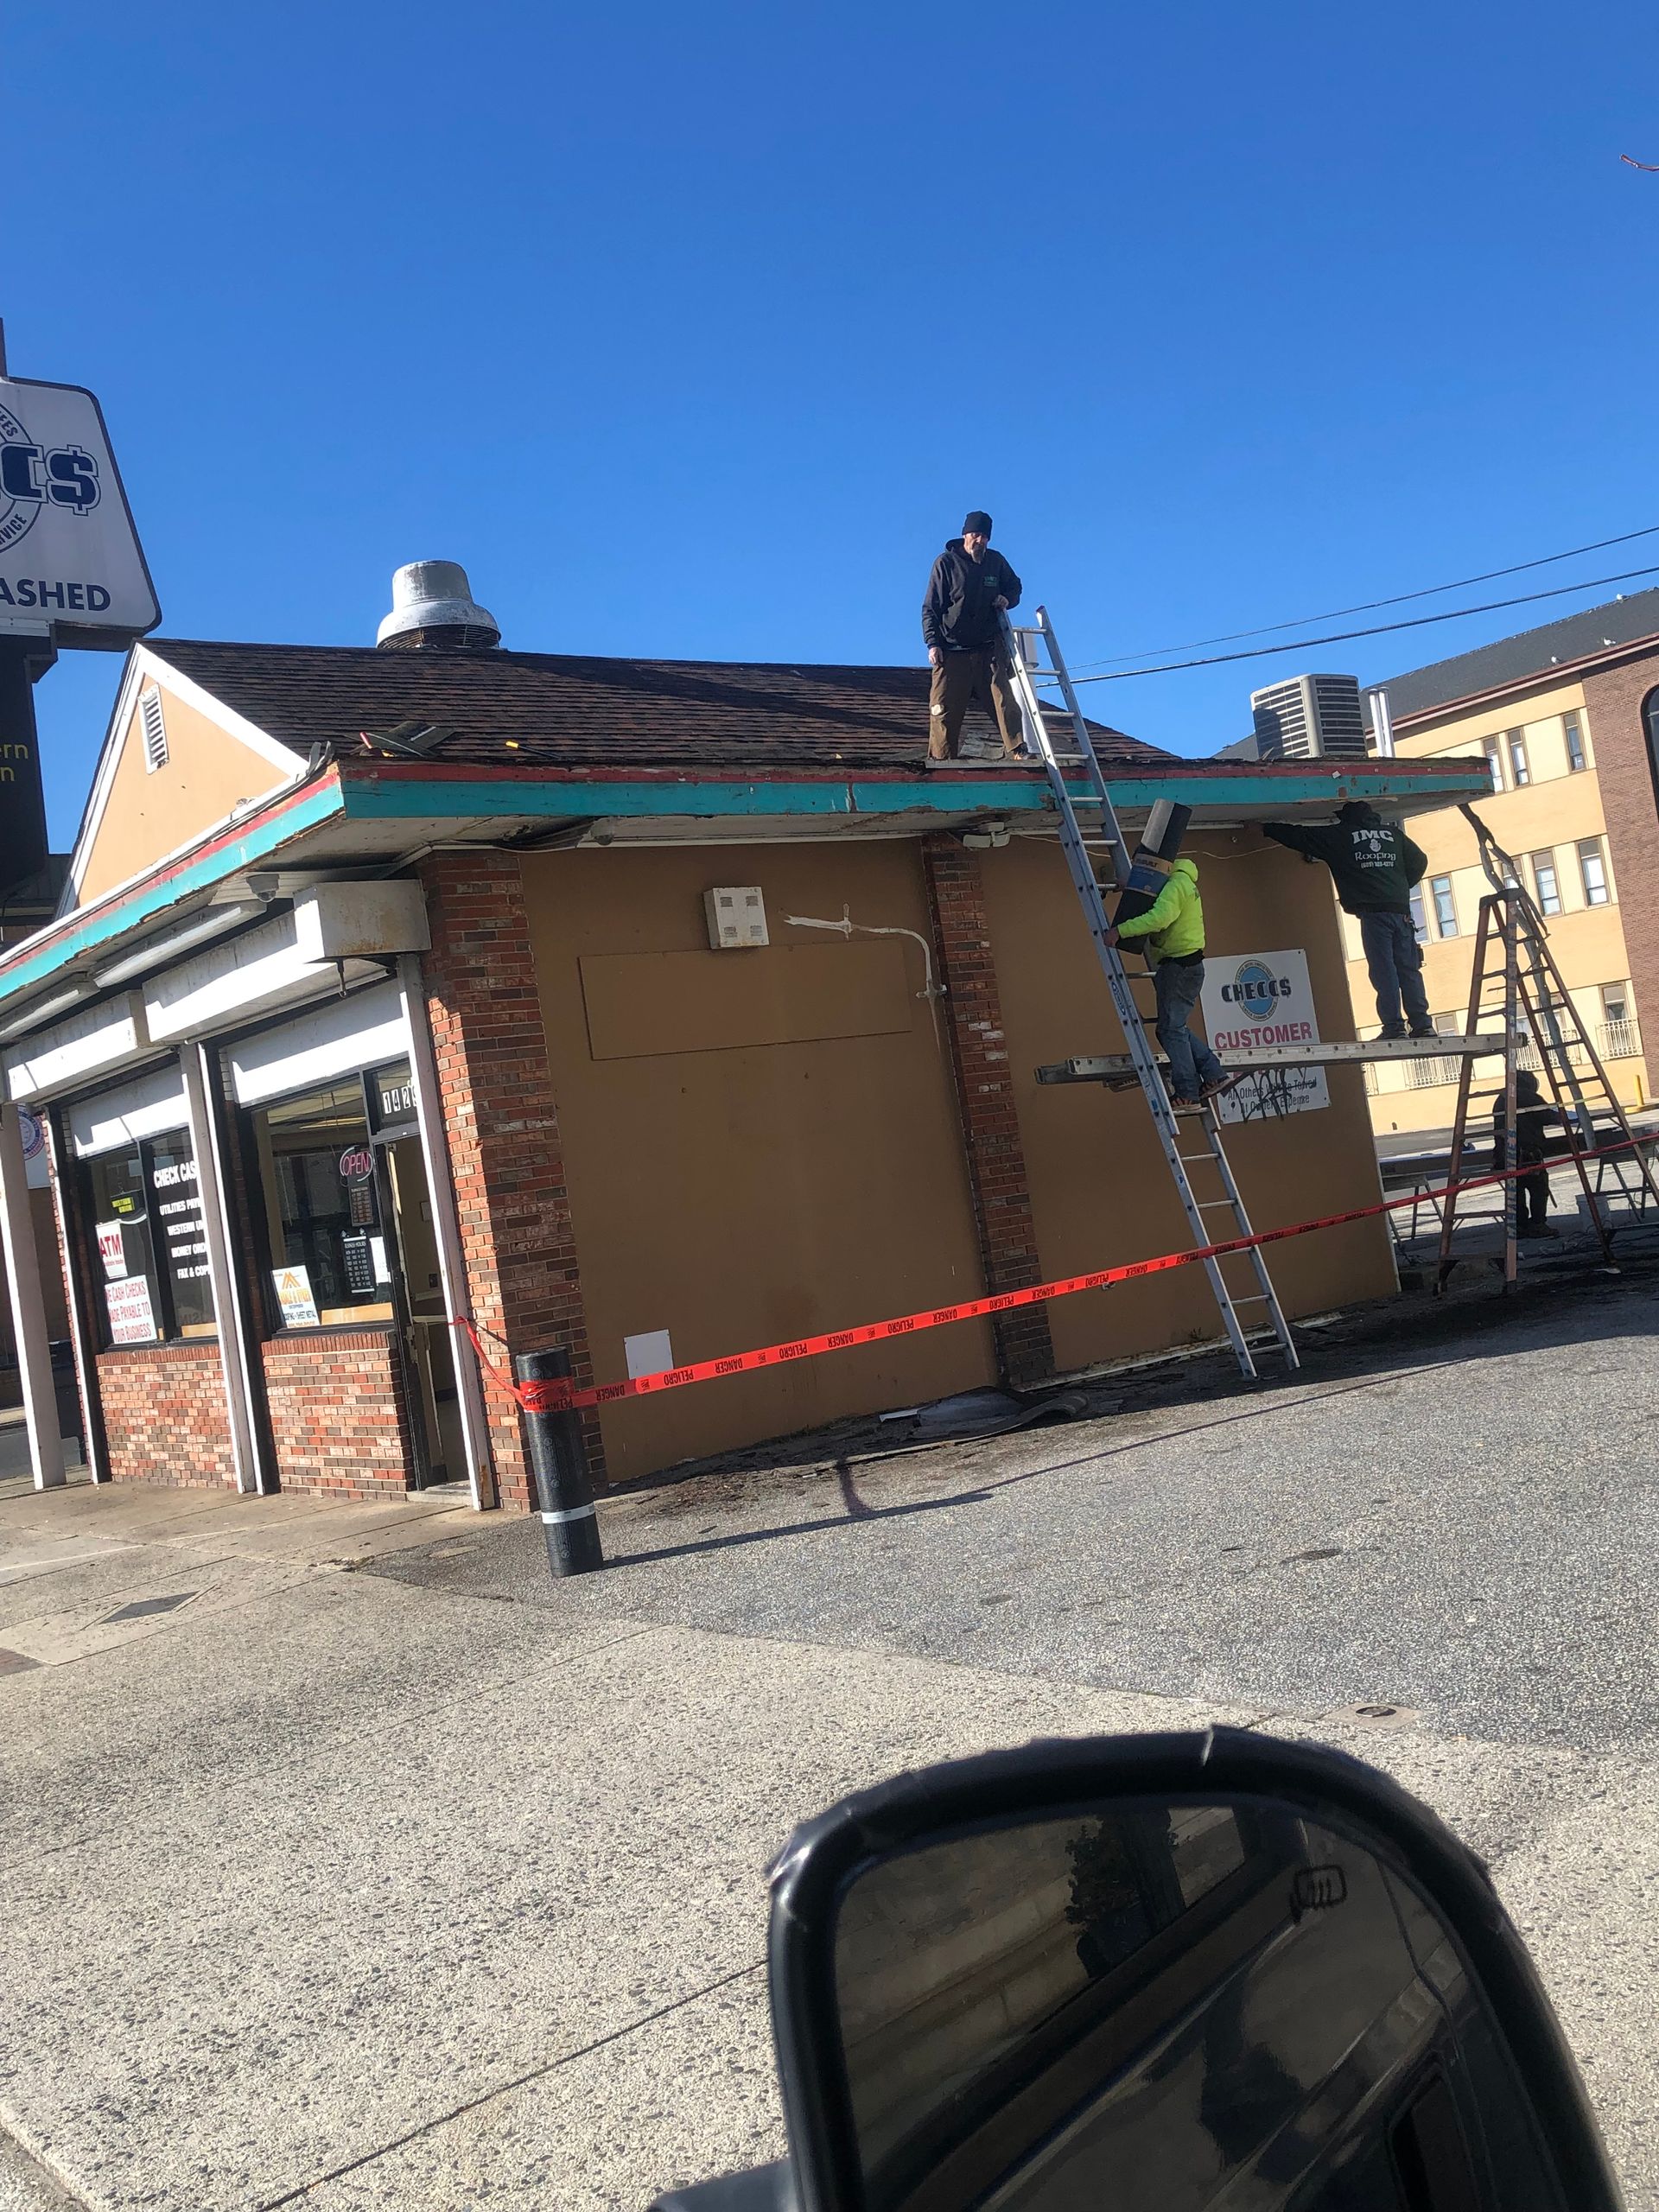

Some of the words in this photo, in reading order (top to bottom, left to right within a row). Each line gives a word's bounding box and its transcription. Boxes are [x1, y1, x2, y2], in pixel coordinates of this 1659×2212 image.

[1351, 830, 1395, 844] IMC
[1354, 851, 1396, 861] Roofing
[1214, 1022, 1313, 1050] CUSTOMER
[343, 1151, 370, 1176] OPEN
[154, 1165, 181, 1188] CHECK
[159, 1200, 186, 1216] UTILITIES
[167, 1221, 195, 1236] WESTERN
[99, 1234, 123, 1258] ATM
[171, 1244, 192, 1258] MONEY
[177, 1268, 189, 1280] FAX
[189, 1267, 195, 1278] &
[1085, 1273, 1109, 1288] PELIGRO
[112, 1286, 125, 1302] CASH
[125, 1281, 147, 1299] CHECKS
[1032, 1285, 1055, 1300] DANGER
[141, 1300, 150, 1316] TO
[989, 1295, 1014, 1310] PELIGRO
[932, 1308, 958, 1324] DANGER
[125, 1322, 152, 1341] BUSINESS
[887, 1318, 914, 1335] PELIGRO
[827, 1332, 854, 1348] DANGER
[779, 1343, 808, 1359] PELIGRO
[715, 1357, 743, 1374] DANGER
[663, 1368, 695, 1386] PELIGRO
[595, 1383, 626, 1402] DANGER
